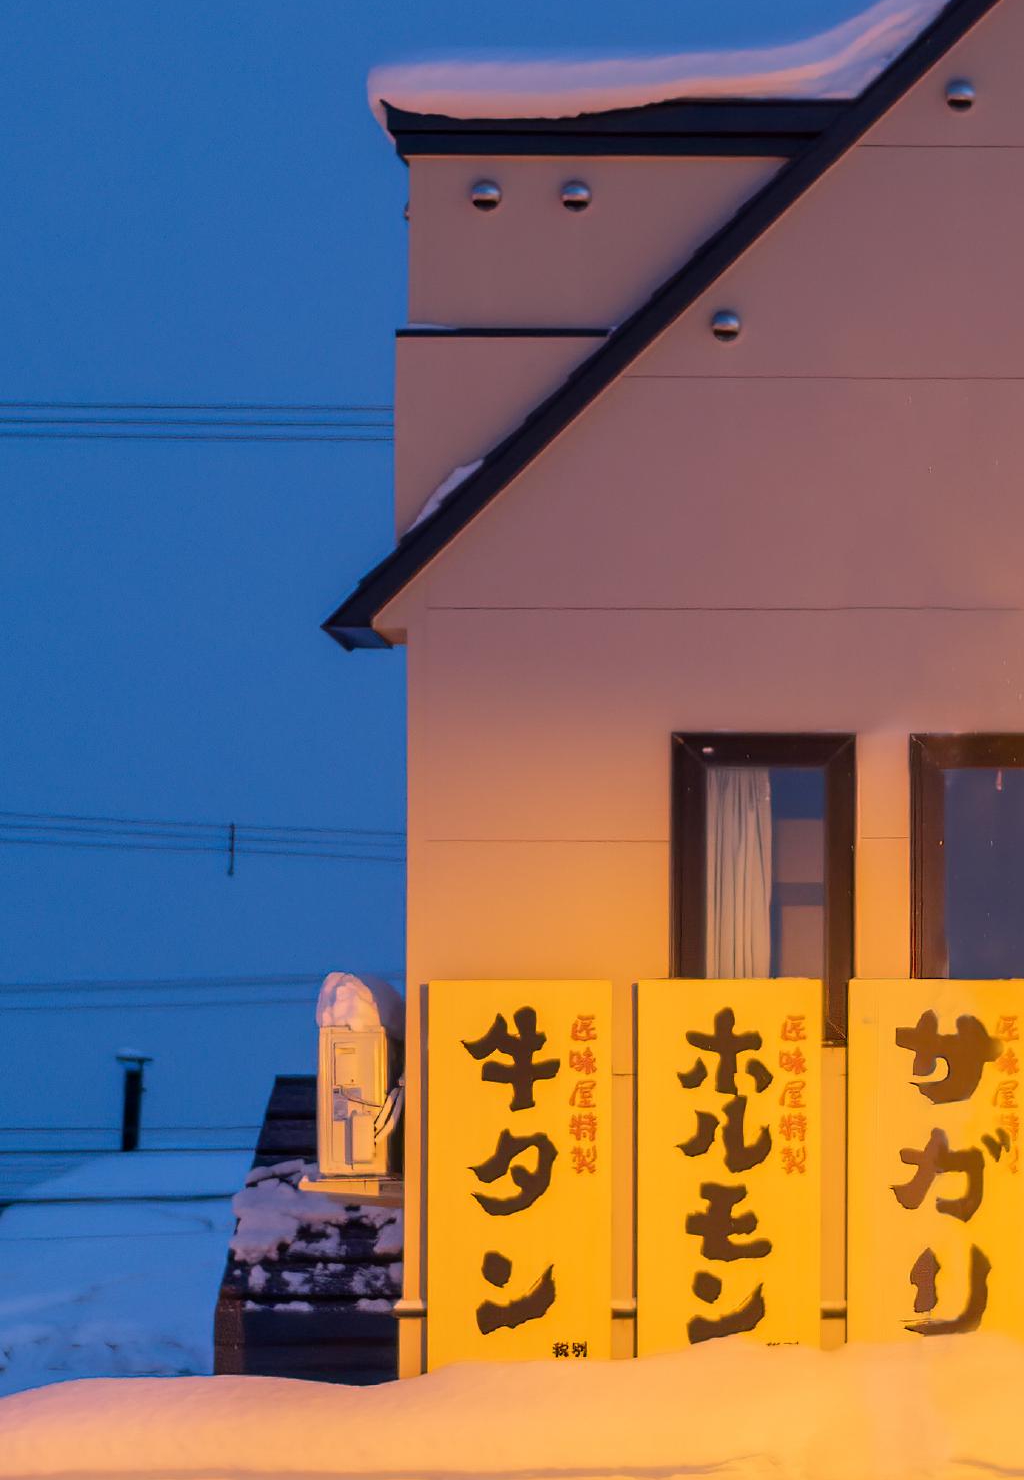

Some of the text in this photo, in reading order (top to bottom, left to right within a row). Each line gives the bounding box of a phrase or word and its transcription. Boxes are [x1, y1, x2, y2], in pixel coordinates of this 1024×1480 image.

[460, 1006, 561, 1335] 牛タン
[674, 1007, 774, 1344] ホルモン
[889, 1009, 1011, 1336] サガリ
